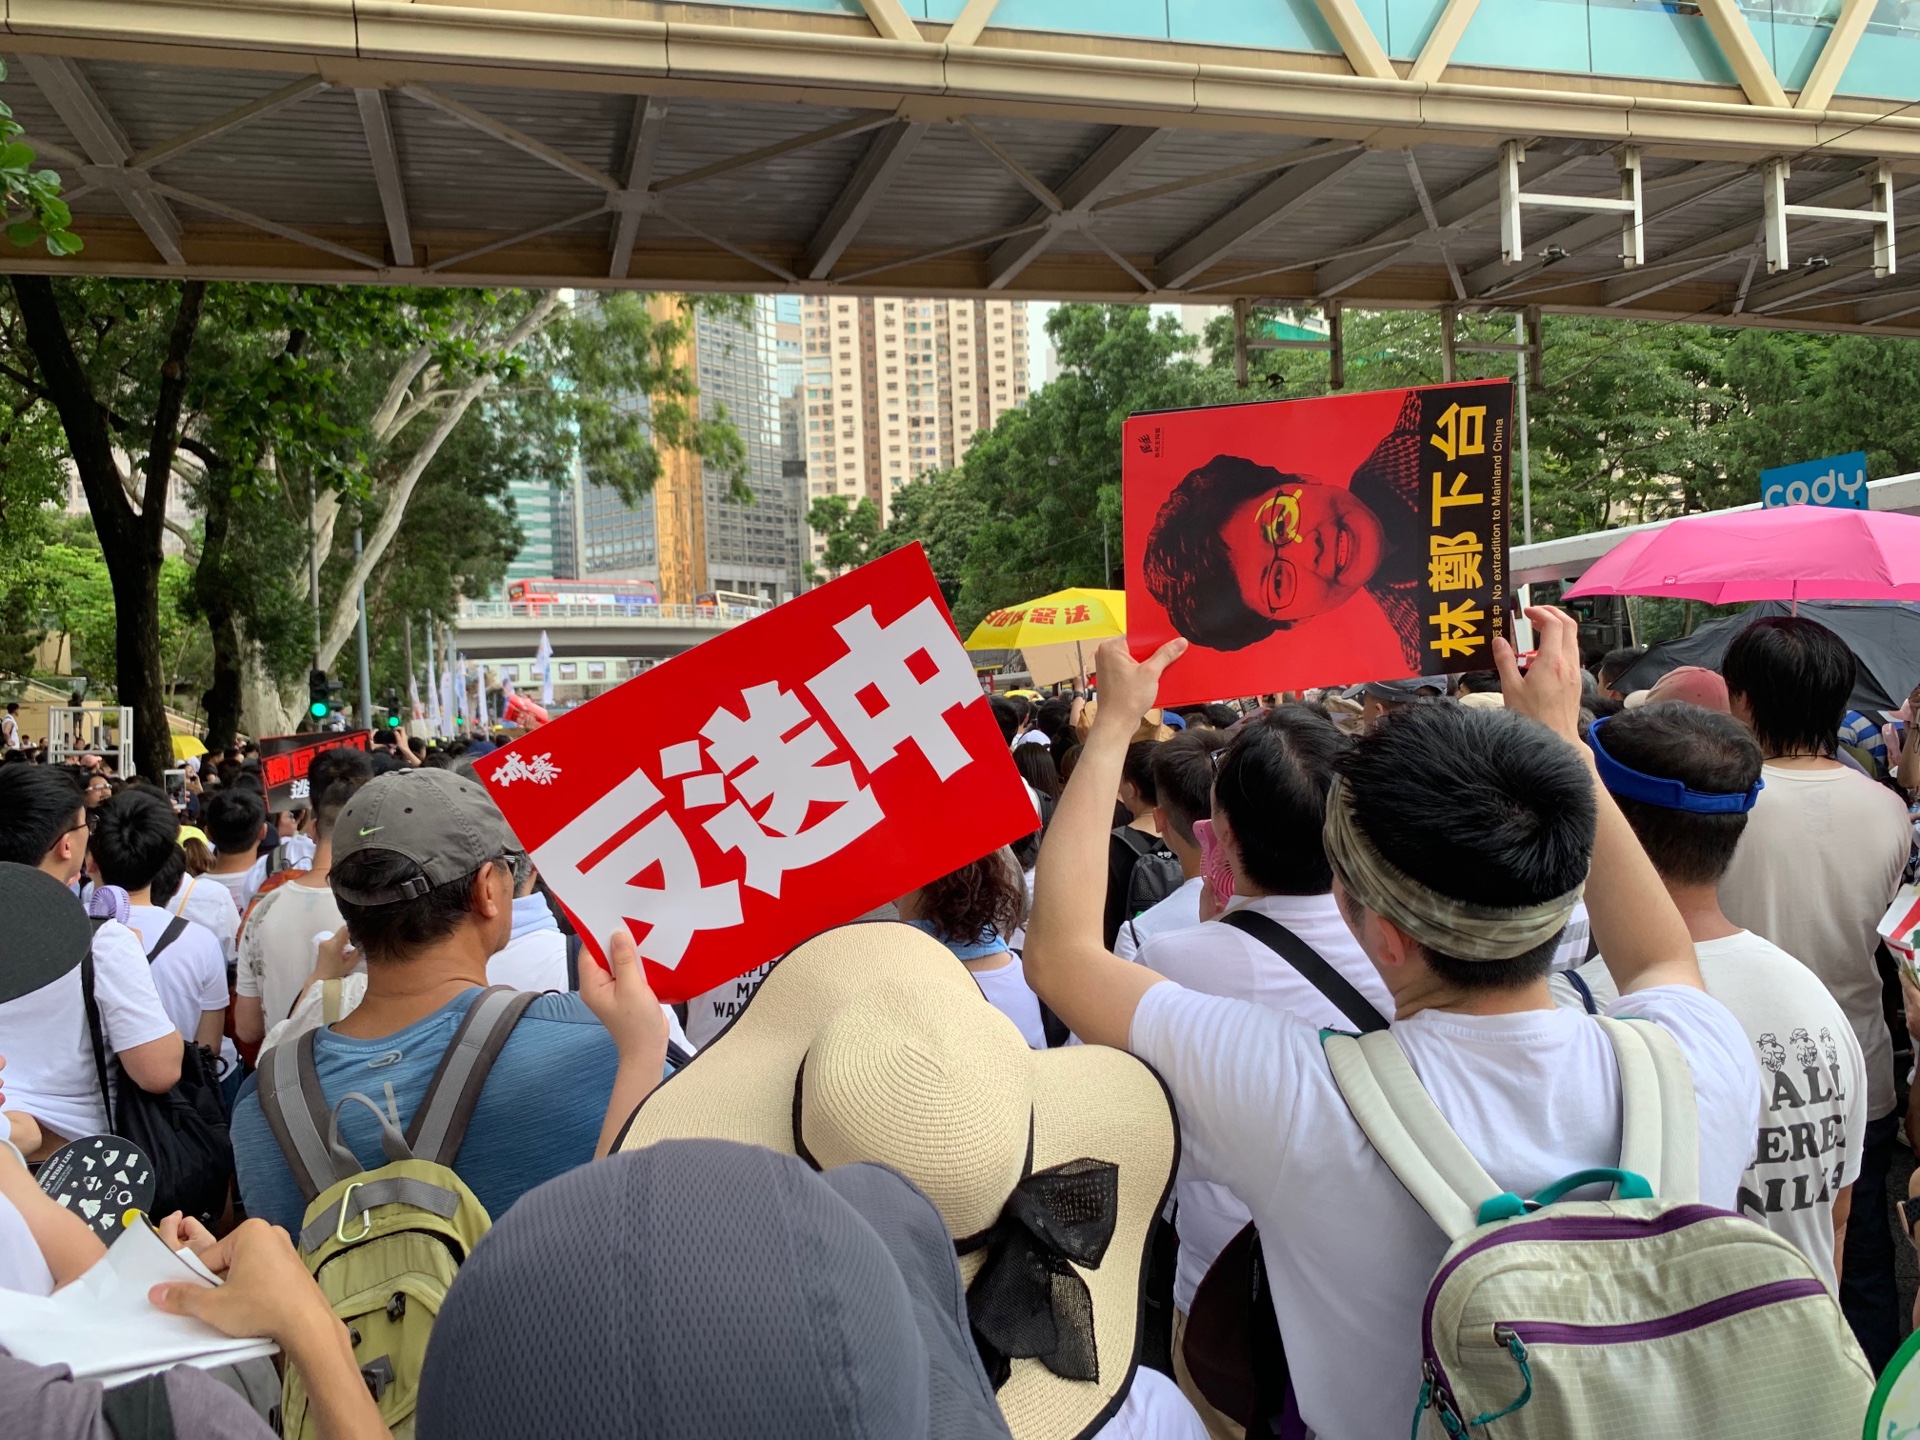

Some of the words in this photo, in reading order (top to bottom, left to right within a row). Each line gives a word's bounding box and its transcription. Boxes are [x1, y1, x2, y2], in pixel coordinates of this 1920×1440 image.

[1492, 418, 1504, 453] China
[1491, 455, 1502, 507] Mainland
[1765, 469, 1863, 509] cody
[1428, 402, 1487, 658] 林鄭下台
[1491, 509, 1501, 522] to
[1491, 523, 1502, 580] extradition
[1492, 584, 1502, 599] No
[530, 597, 984, 970] 反送中
[48, 1156, 59, 1170] SHOP
[49, 1163, 64, 1181] WISH
[62, 1148, 75, 1164] LIST
